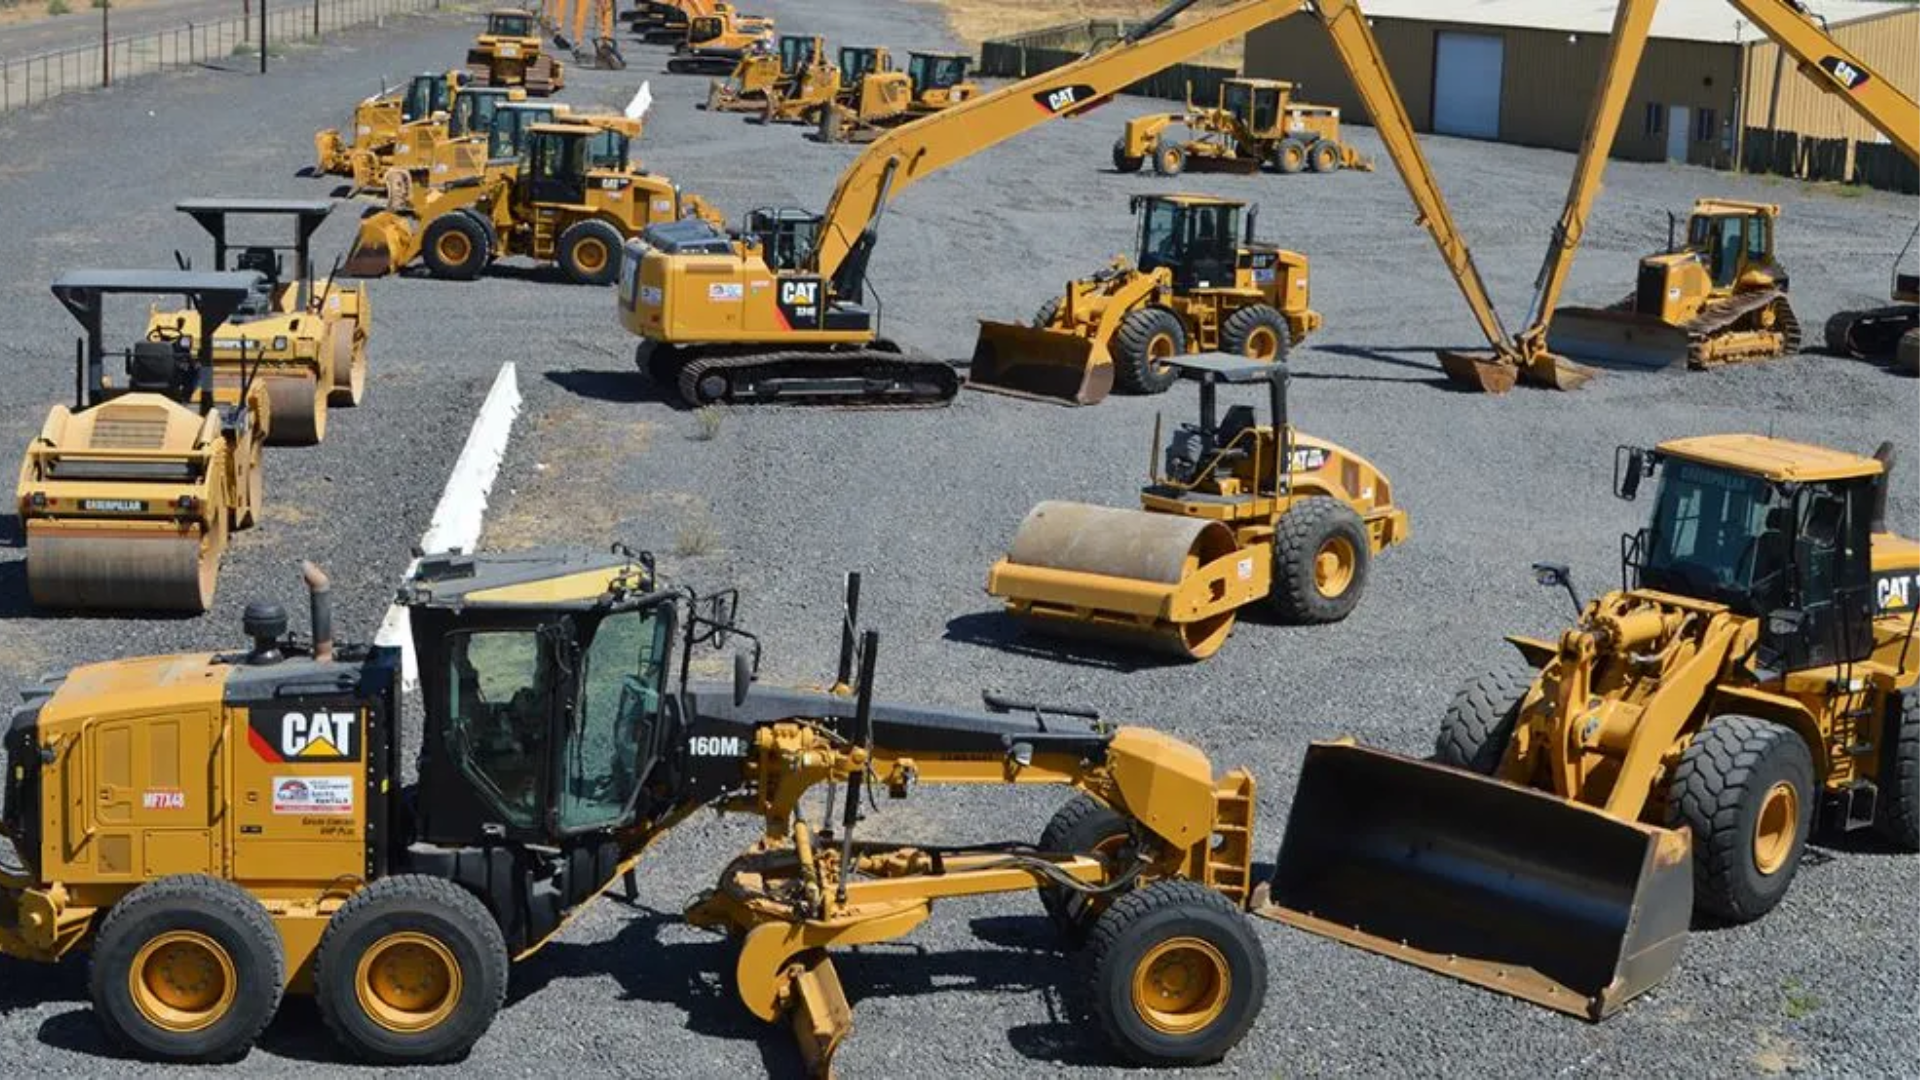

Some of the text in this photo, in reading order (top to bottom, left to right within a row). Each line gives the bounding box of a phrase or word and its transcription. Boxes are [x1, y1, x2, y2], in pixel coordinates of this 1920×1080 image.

[1834, 61, 1858, 87] CAT
[1048, 86, 1075, 110] CAT
[782, 282, 817, 305] CAT
[1877, 576, 1910, 608] CAT
[282, 712, 355, 756] CAT
